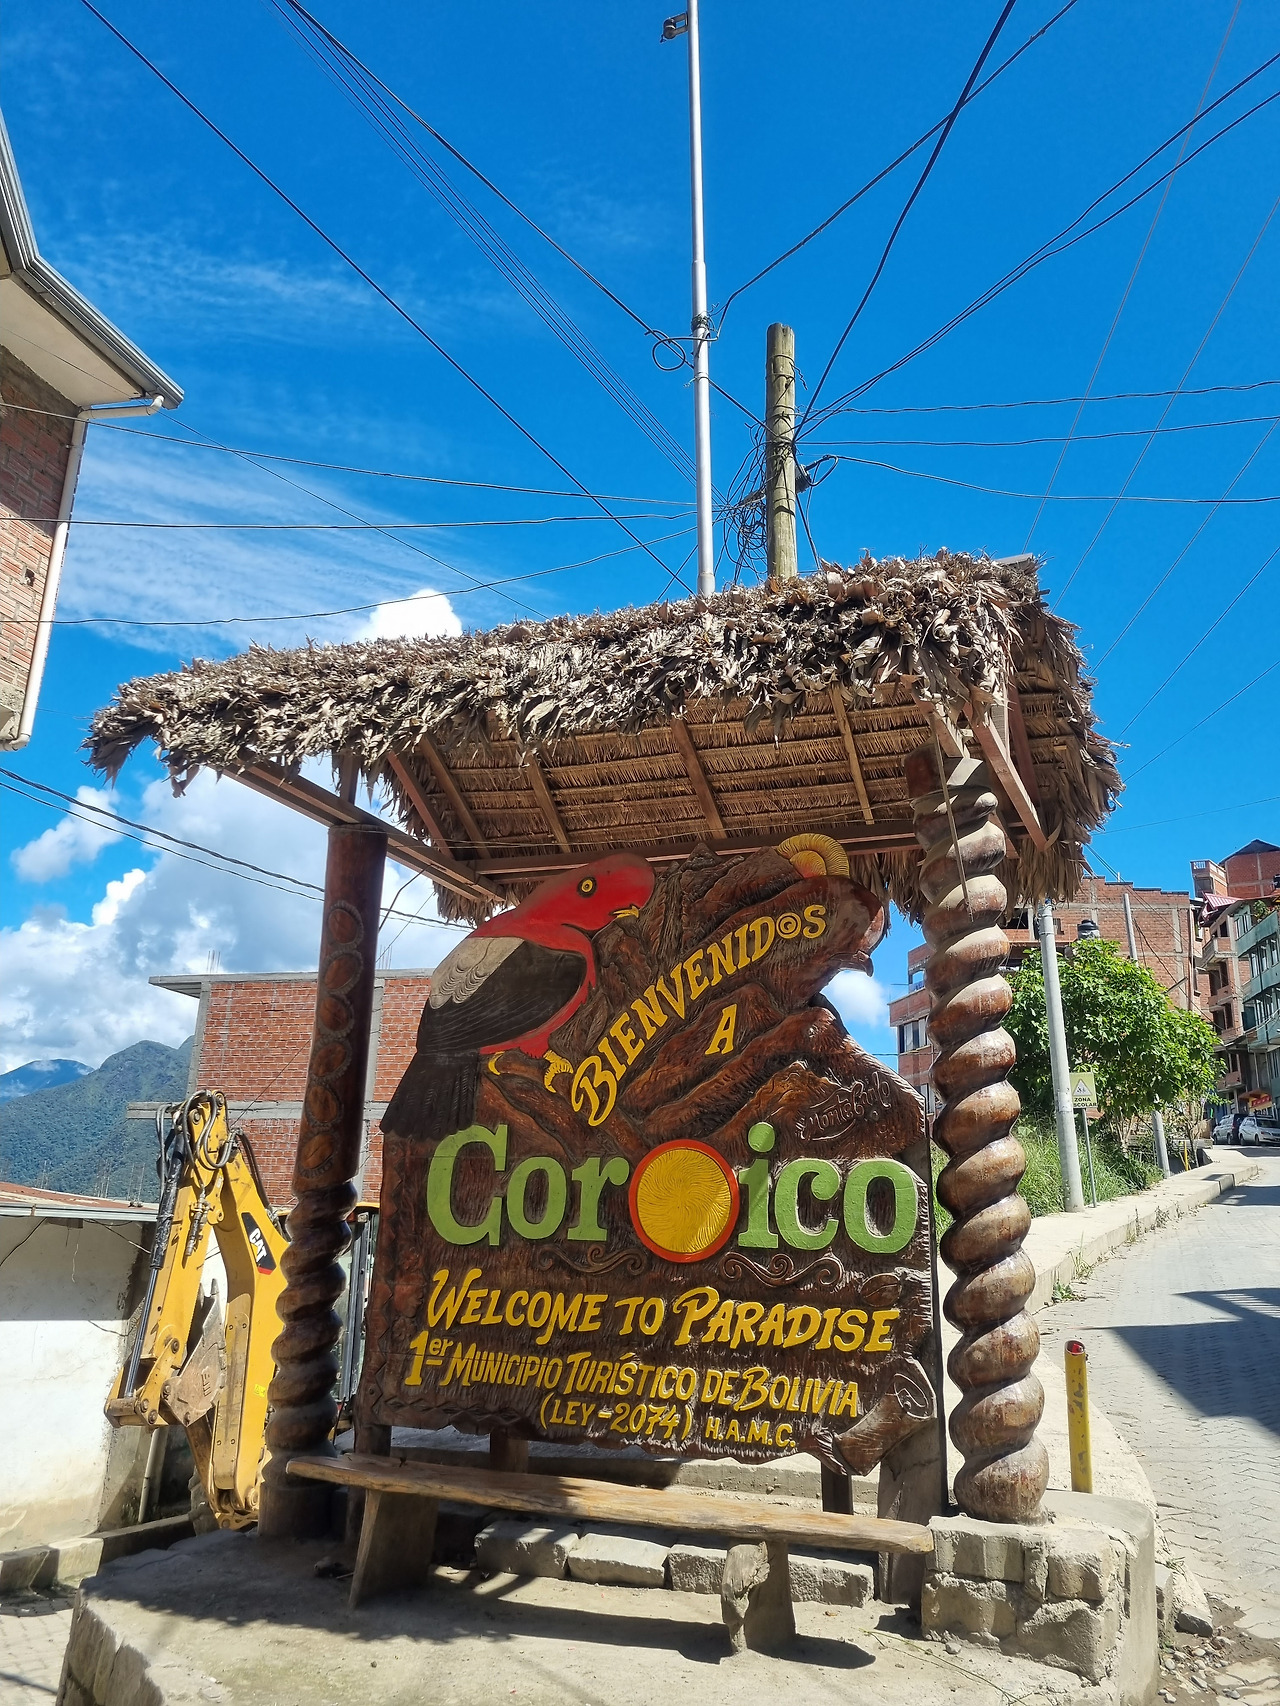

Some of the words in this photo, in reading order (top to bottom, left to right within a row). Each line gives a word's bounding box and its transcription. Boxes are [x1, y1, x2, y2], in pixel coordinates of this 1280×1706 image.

[569, 902, 828, 1128] BIENVENIDOS
[704, 1003, 738, 1056] A
[249, 1227, 267, 1263] CAT
[426, 1267, 609, 1345] WELCOME
[614, 1296, 665, 1336] TO
[672, 1286, 901, 1352] PARADISE
[403, 1330, 454, 1387] 1er
[438, 1342, 564, 1390] MUNICIPIO
[700, 1370, 738, 1406] DE
[733, 1366, 859, 1418] BOLIVIA
[704, 1417, 797, 1449] H.A.M.C.
